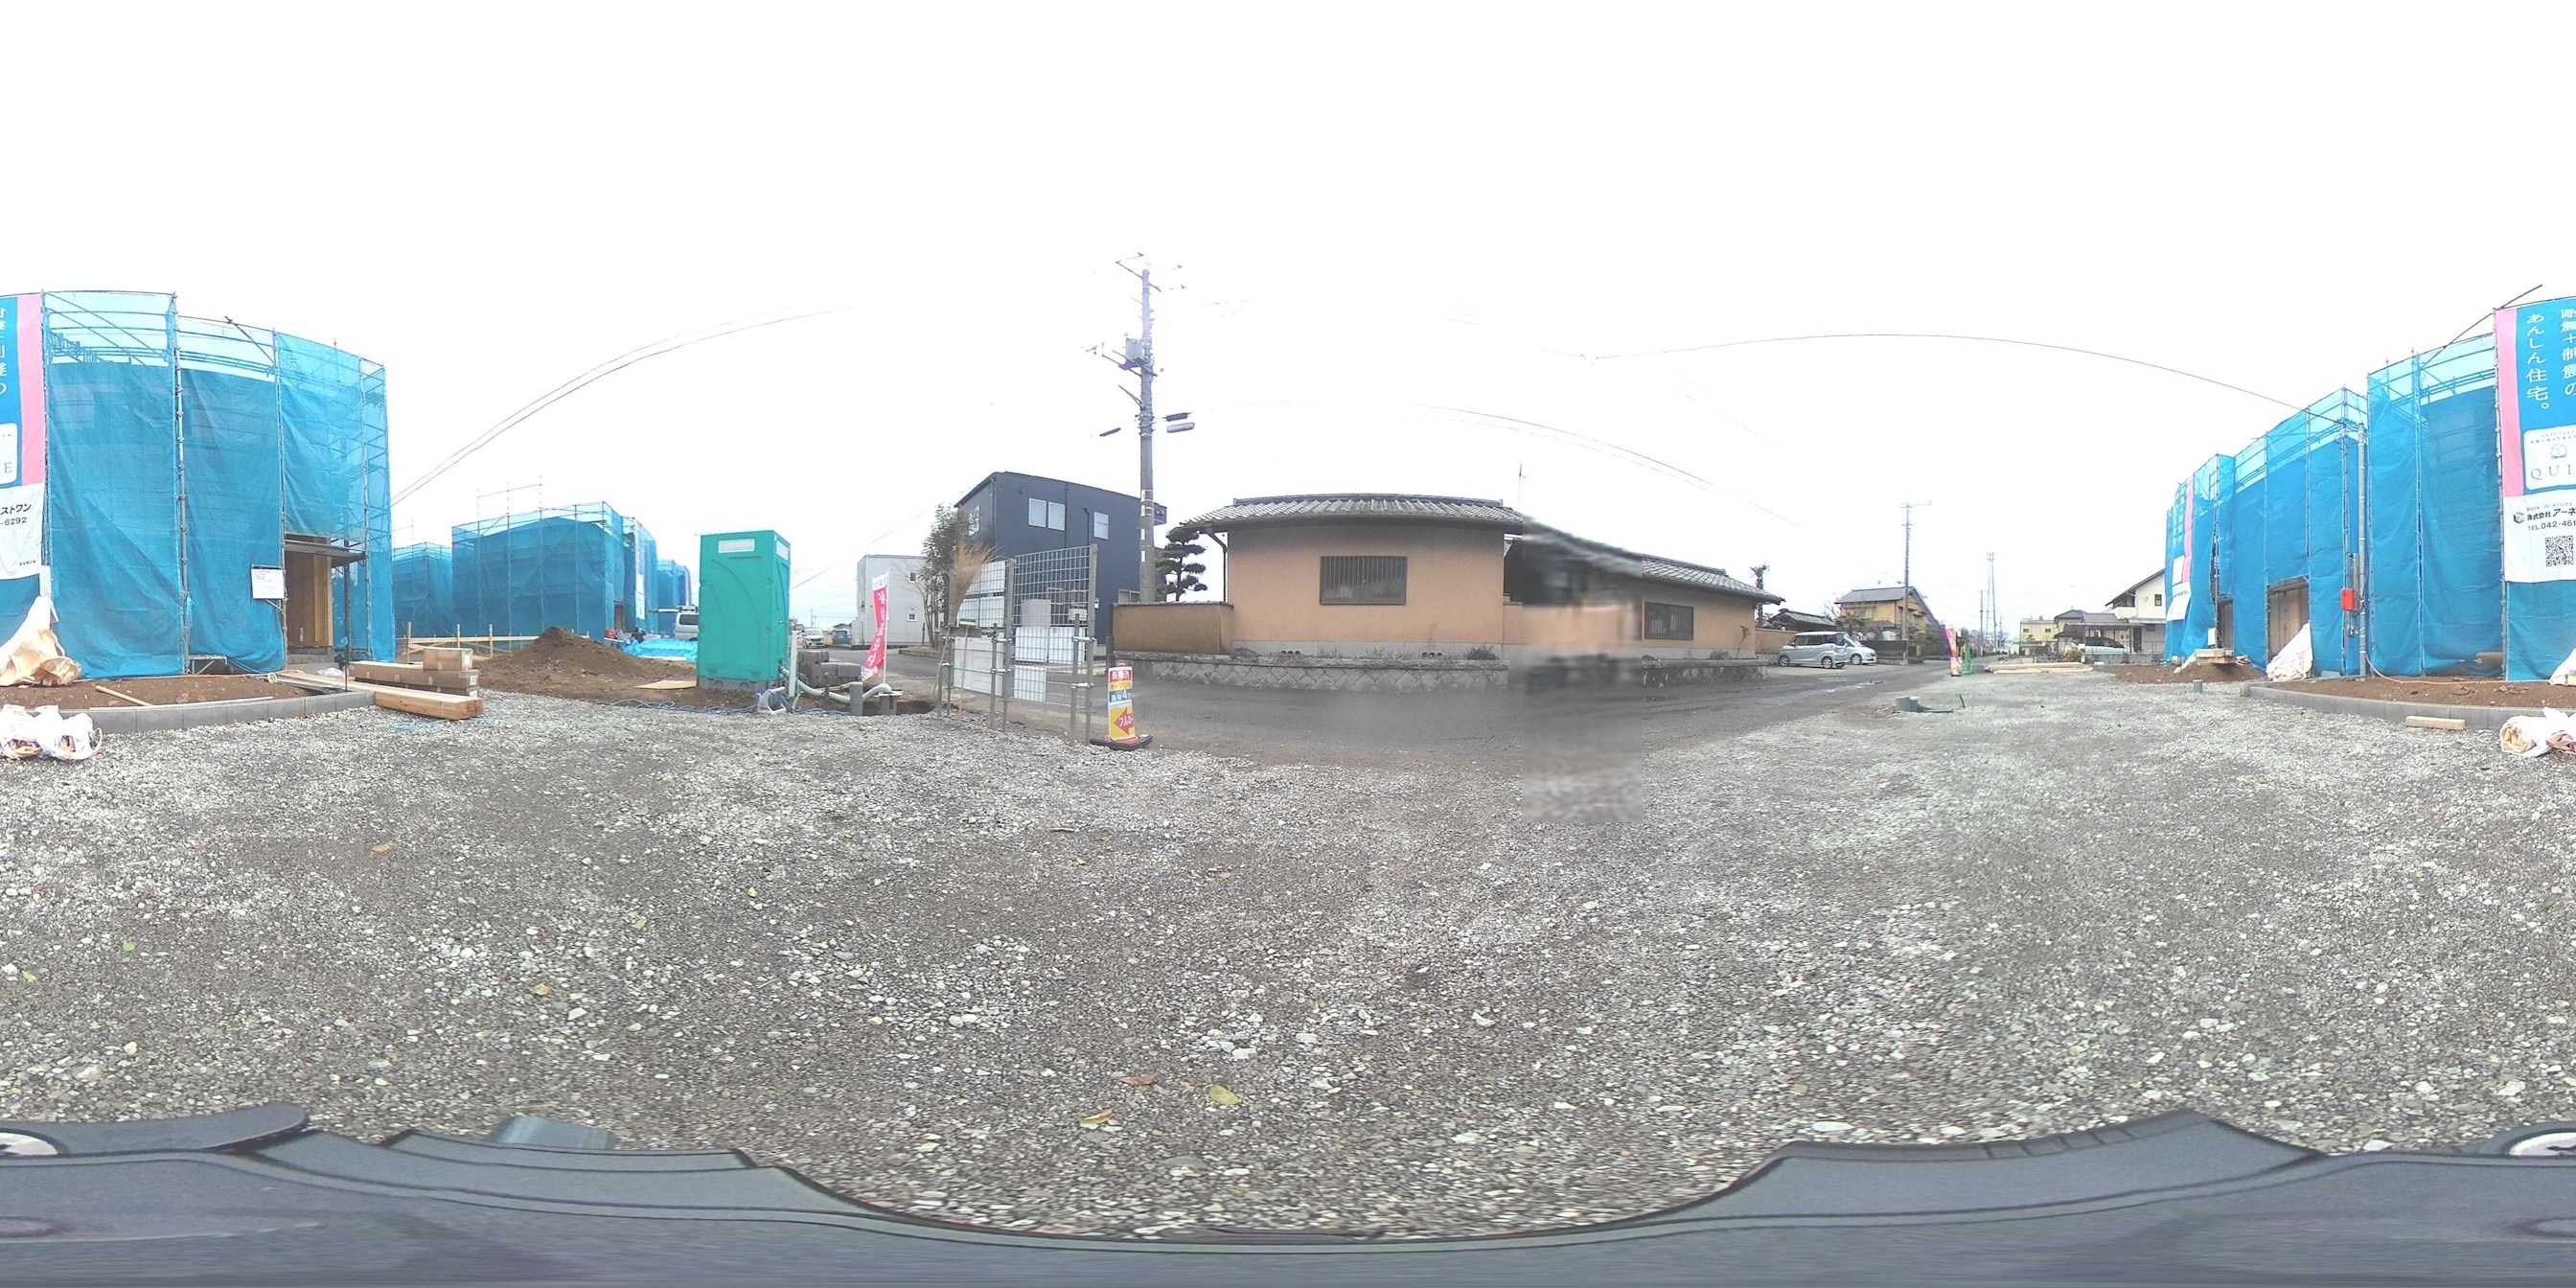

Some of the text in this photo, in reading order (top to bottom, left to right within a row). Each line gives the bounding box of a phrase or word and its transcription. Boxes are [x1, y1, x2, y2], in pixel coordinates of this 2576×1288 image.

[2525, 313, 2550, 410] あんしん住宅。
